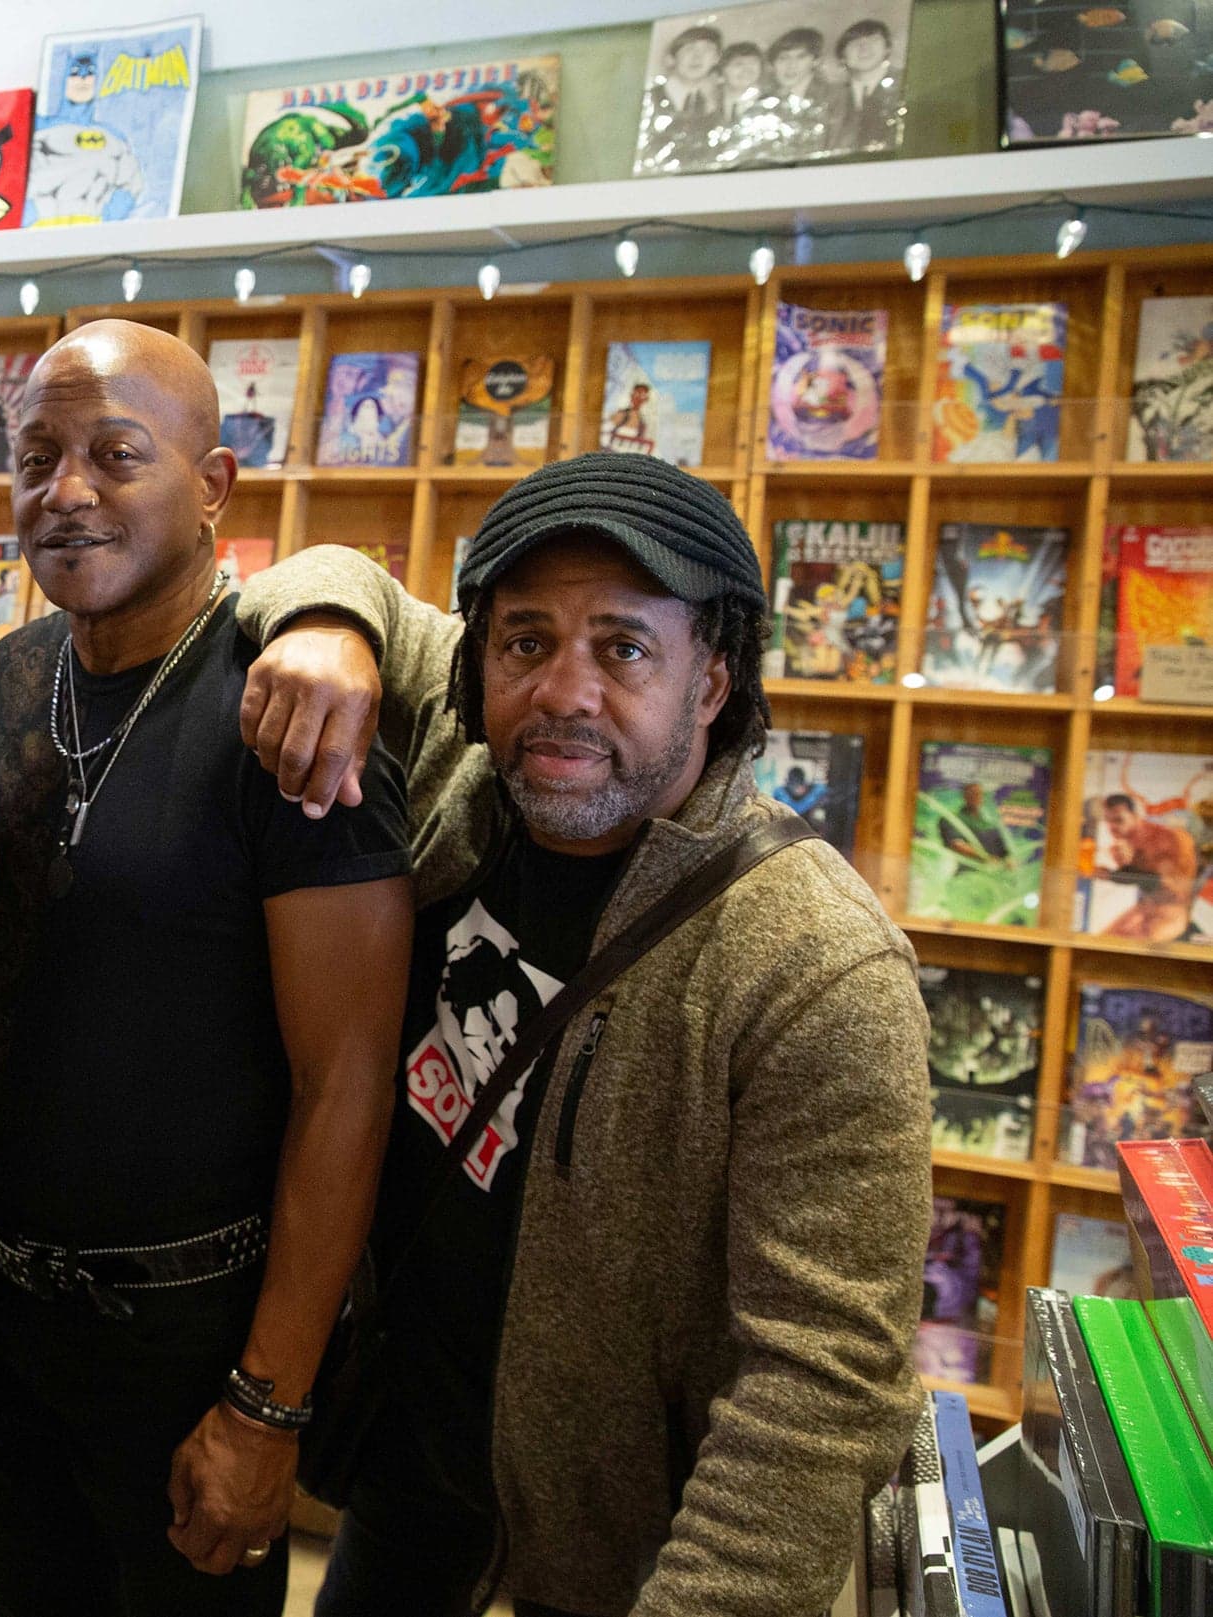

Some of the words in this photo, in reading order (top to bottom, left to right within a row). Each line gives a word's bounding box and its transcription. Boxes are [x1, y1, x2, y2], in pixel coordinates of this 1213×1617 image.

[98, 43, 190, 98] BATMAN
[281, 85, 347, 108] HALL
[357, 79, 388, 100] OF
[397, 64, 518, 95] JUSTICE
[795, 312, 875, 333] SONIC
[408, 1058, 488, 1177] SOL
[958, 1525, 995, 1567] DYLAN
[966, 1568, 1000, 1598] BOB
